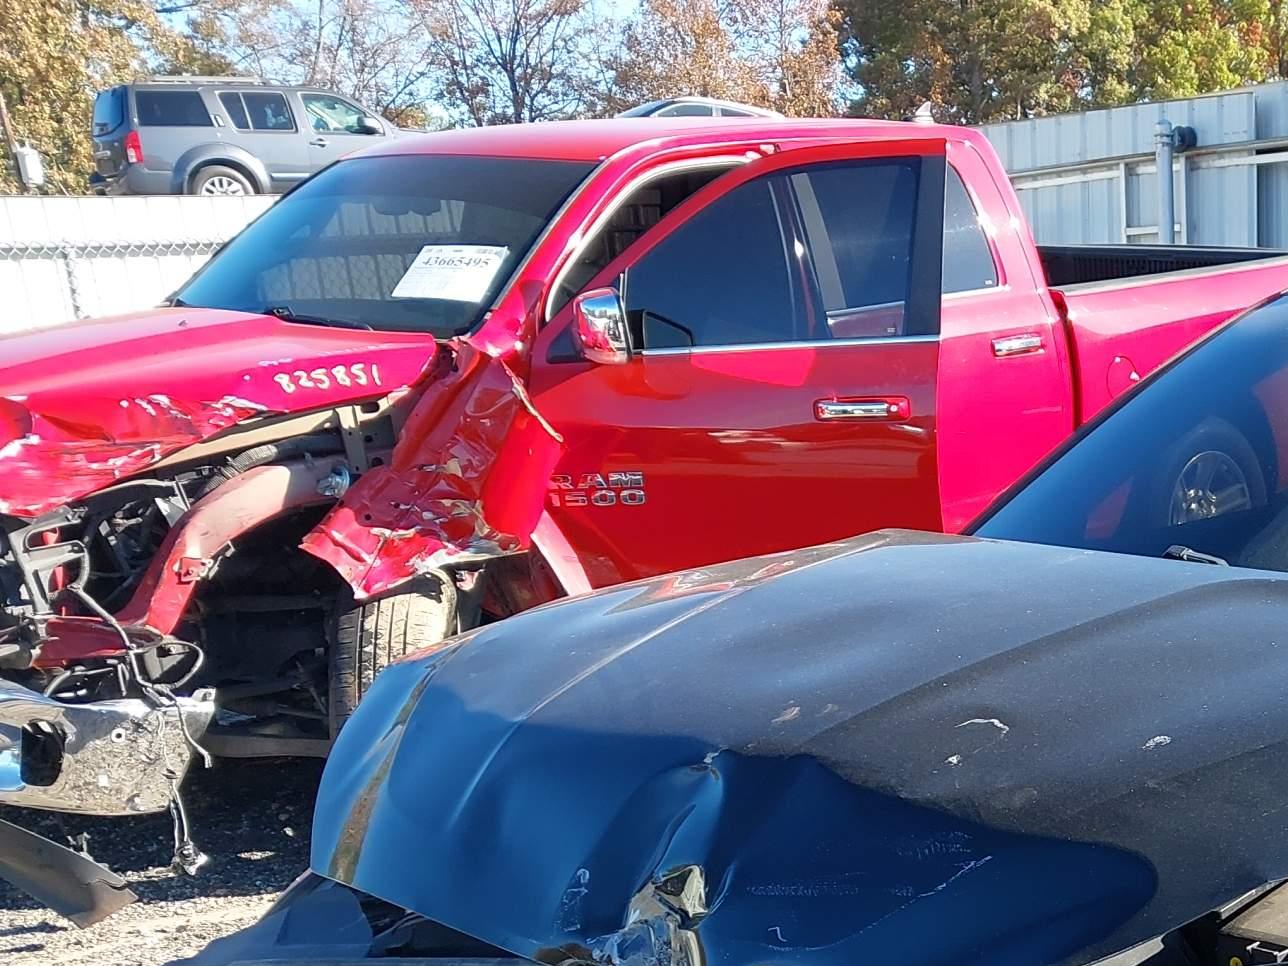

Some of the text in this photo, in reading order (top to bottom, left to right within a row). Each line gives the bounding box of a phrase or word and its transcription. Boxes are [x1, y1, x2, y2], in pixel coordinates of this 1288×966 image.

[422, 256, 491, 269] 43665495
[273, 363, 383, 394] 825851
[549, 472, 645, 489] RAM
[548, 489, 647, 507] 1500
